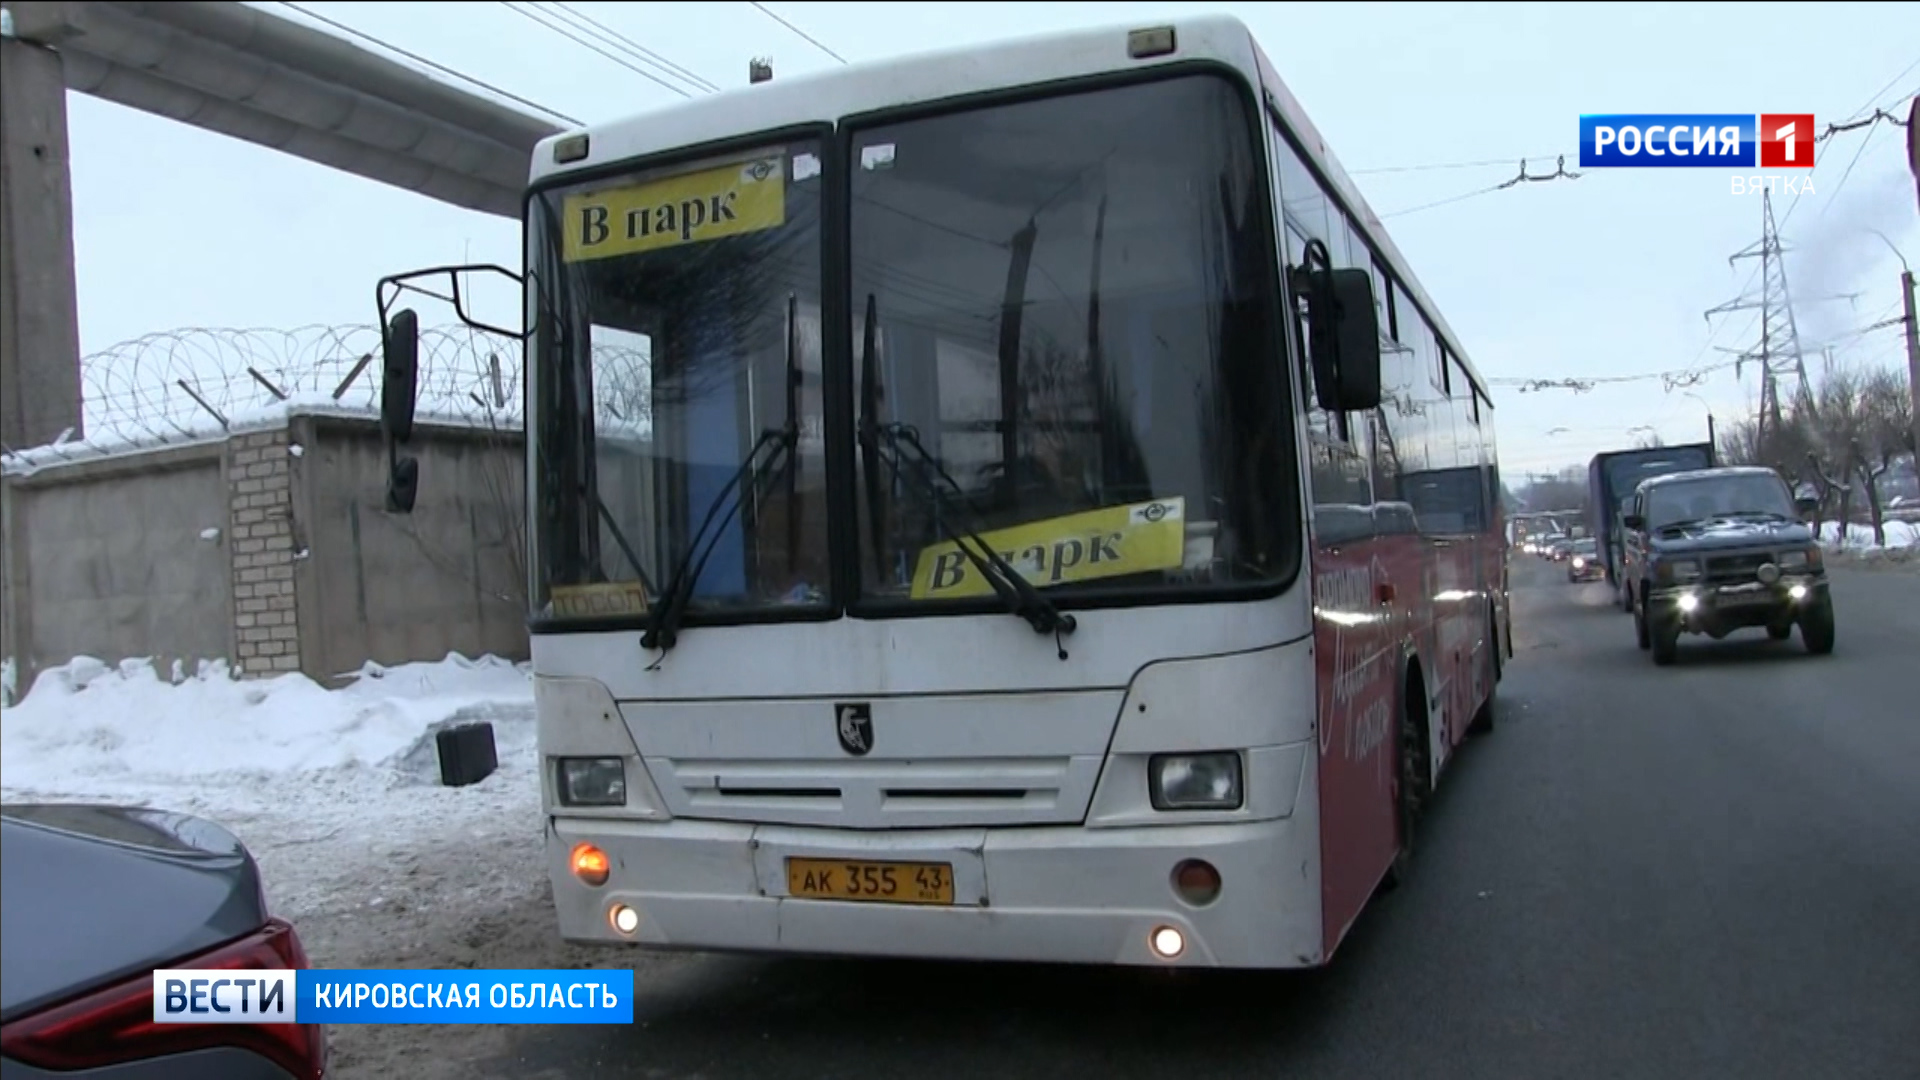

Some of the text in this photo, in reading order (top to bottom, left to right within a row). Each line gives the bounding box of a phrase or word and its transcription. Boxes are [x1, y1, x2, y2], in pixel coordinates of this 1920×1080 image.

[580, 190, 736, 246] В парк
[931, 550, 966, 589] В
[803, 865, 942, 895] АК 355 43
